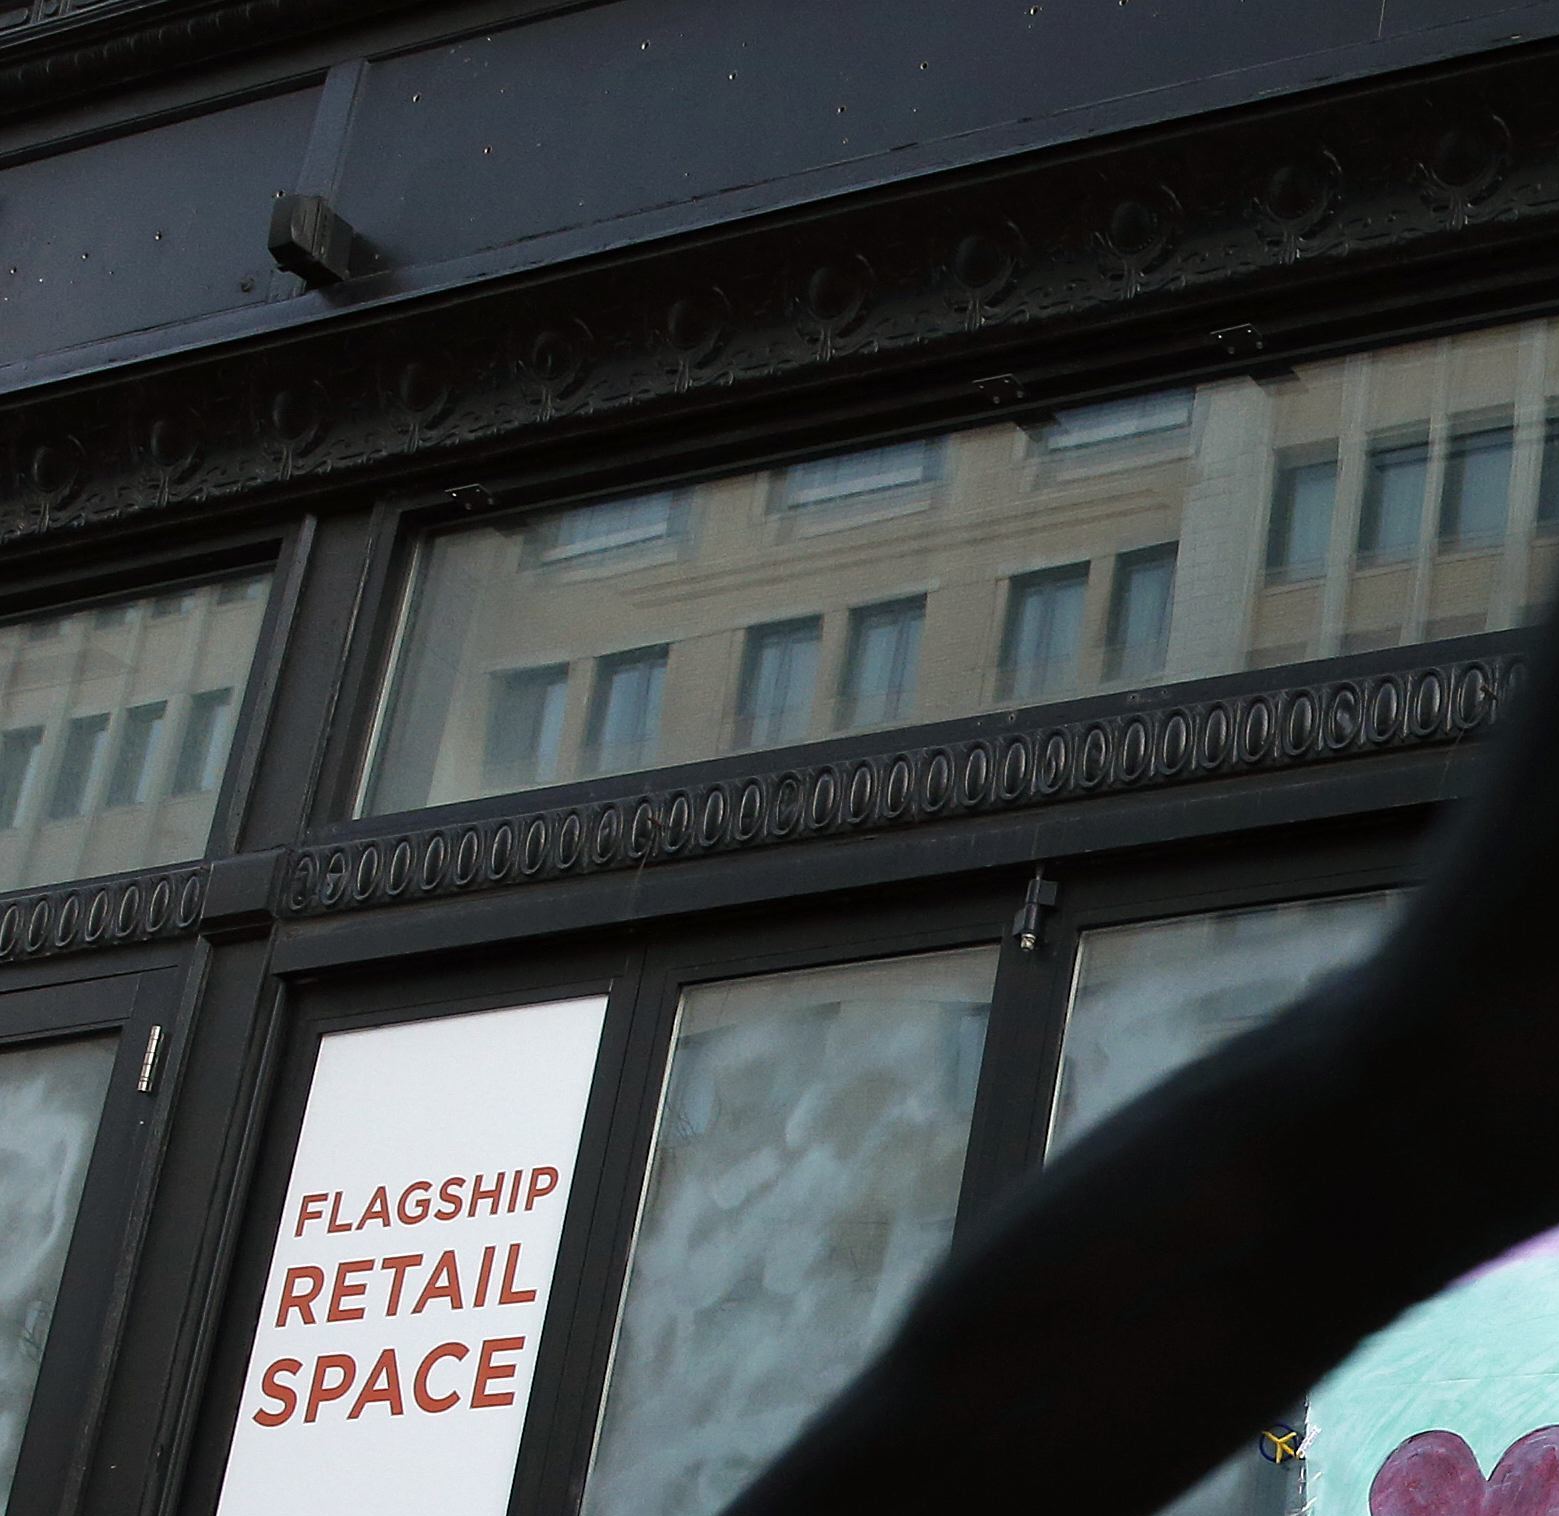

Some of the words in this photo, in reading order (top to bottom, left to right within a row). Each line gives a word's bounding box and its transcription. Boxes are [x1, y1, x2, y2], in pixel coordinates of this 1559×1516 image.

[294, 1165, 560, 1238] FLAGSHIP
[275, 1241, 538, 1329] RETAIL
[252, 1335, 527, 1428] SPACE
